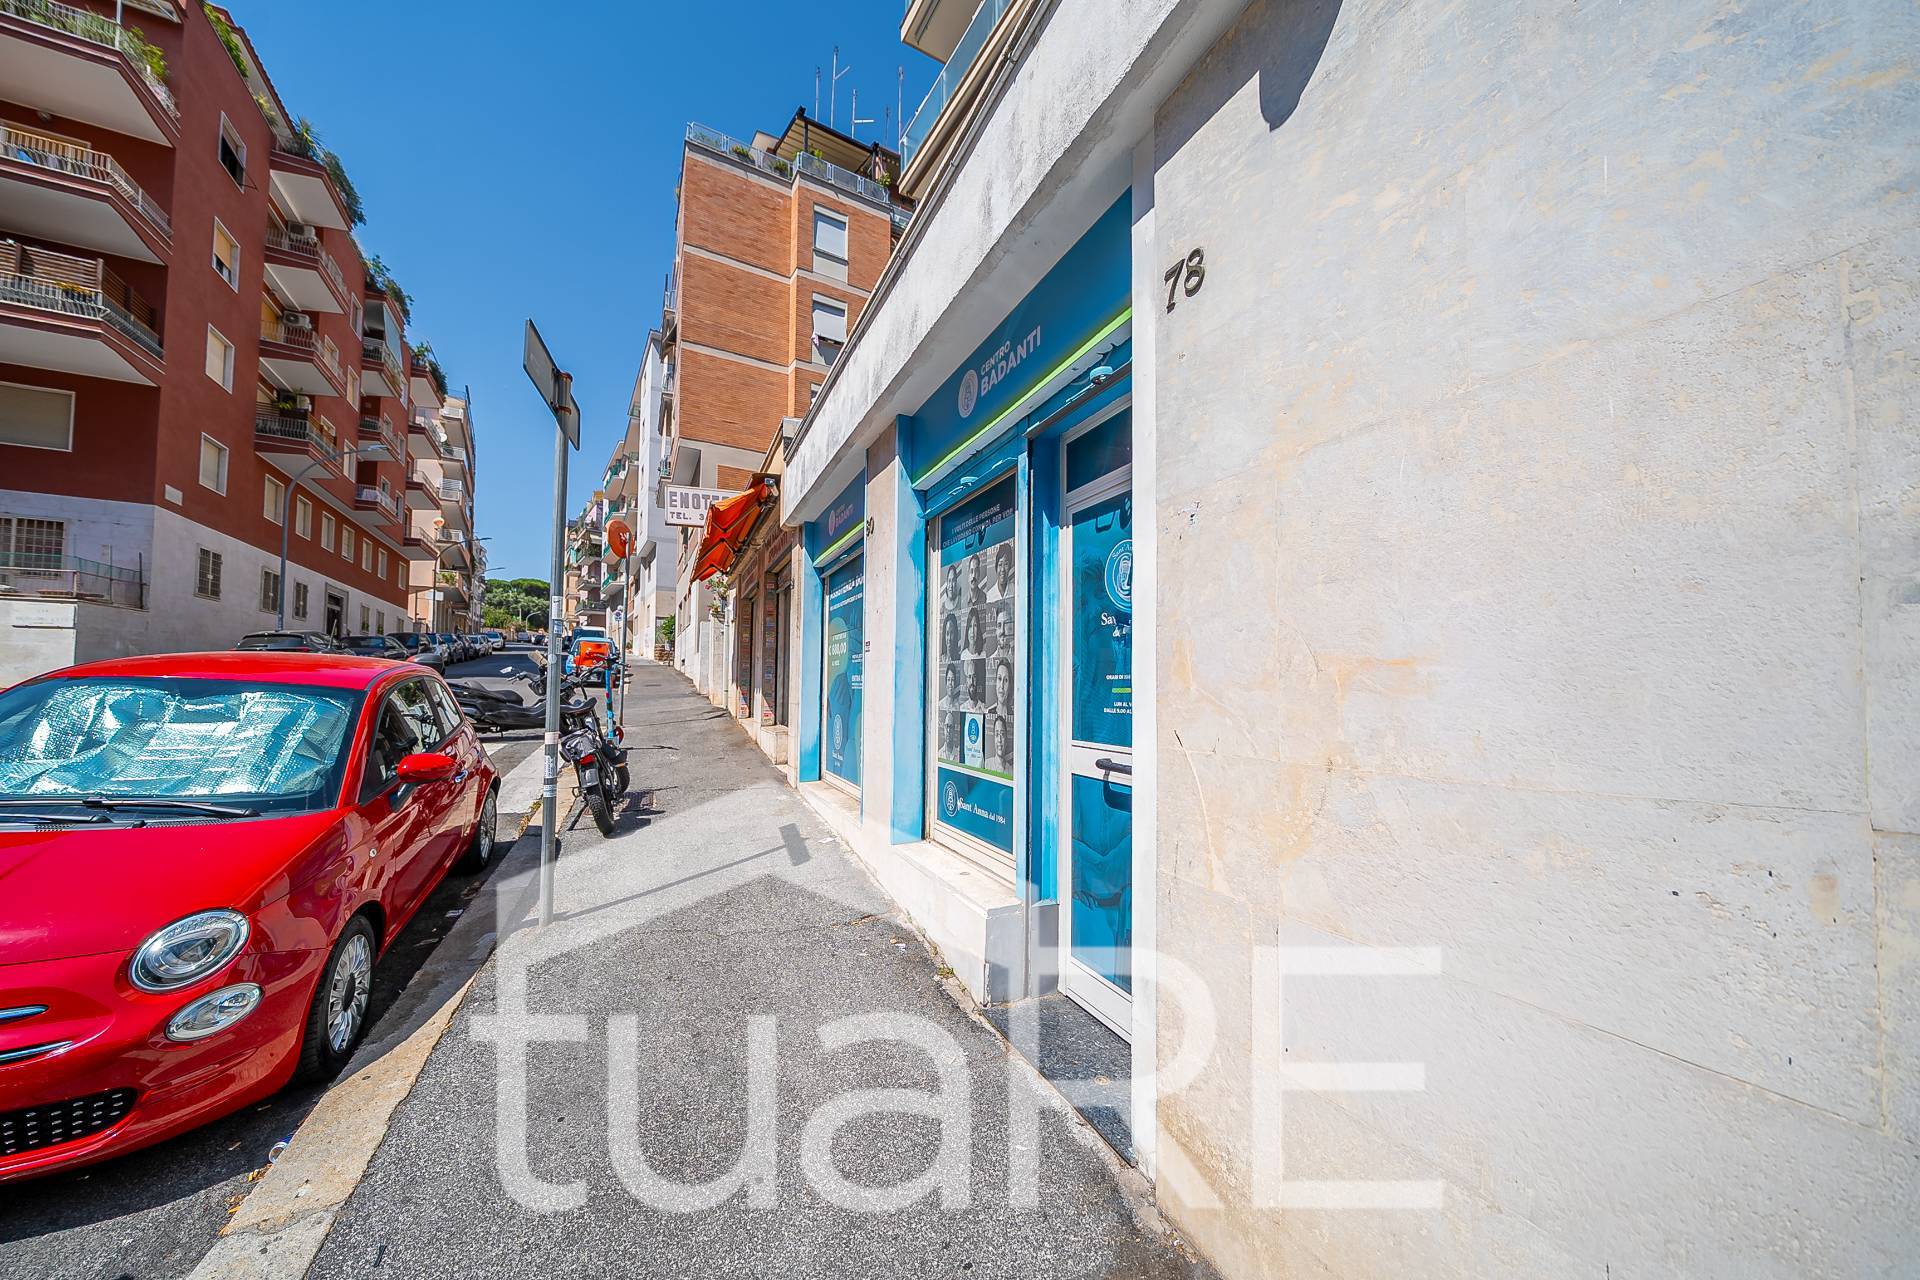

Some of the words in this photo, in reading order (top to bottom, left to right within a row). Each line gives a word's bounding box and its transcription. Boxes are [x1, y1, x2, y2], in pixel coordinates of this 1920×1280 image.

[1163, 246, 1206, 315] 78
[981, 341, 1010, 375] CENTRO
[981, 325, 1041, 397] BADANTI
[670, 511, 692, 520] TEL.
